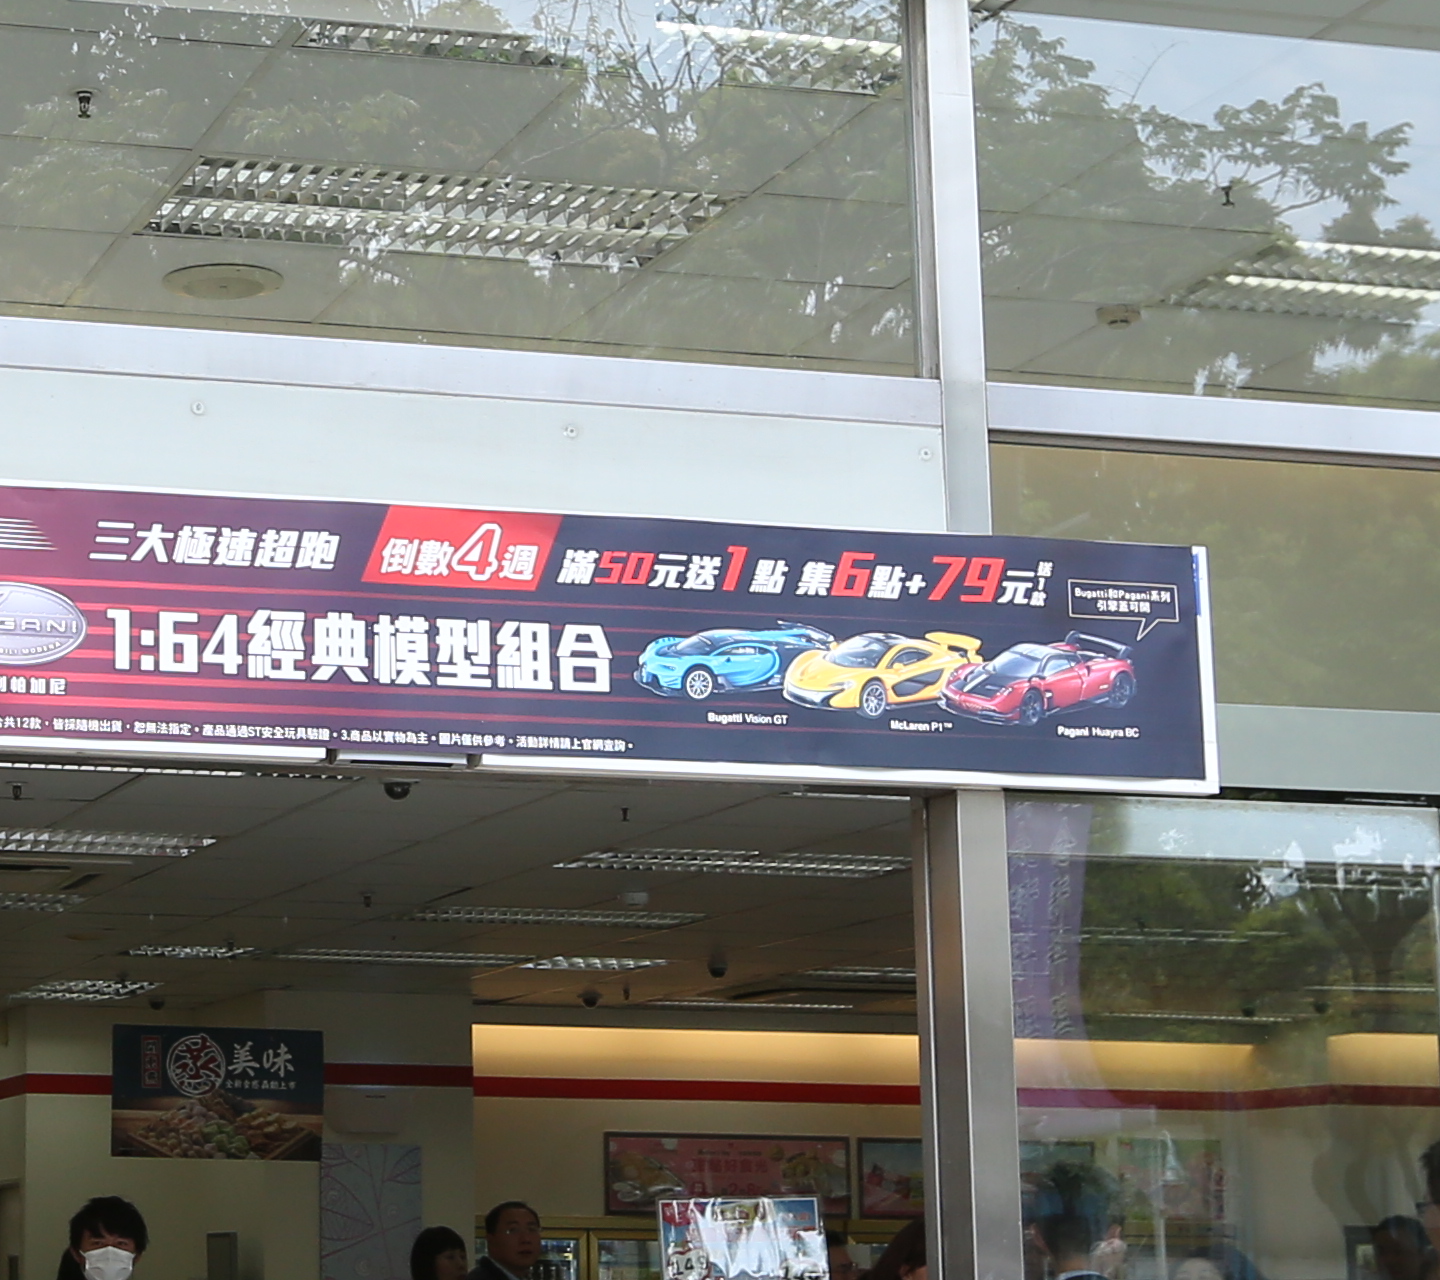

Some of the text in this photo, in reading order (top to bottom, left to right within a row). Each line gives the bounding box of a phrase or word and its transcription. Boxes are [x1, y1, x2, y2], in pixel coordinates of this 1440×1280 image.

[88, 519, 342, 571] 三大極速超跑
[380, 522, 541, 582] 倒數4週
[105, 607, 614, 694] 1:64經典模型組合
[707, 712, 788, 726] Bugatti Vision GT
[890, 719, 929, 732] McLaren
[1057, 725, 1140, 739] Pagani Huayra BC
[227, 1041, 296, 1078] 美味
